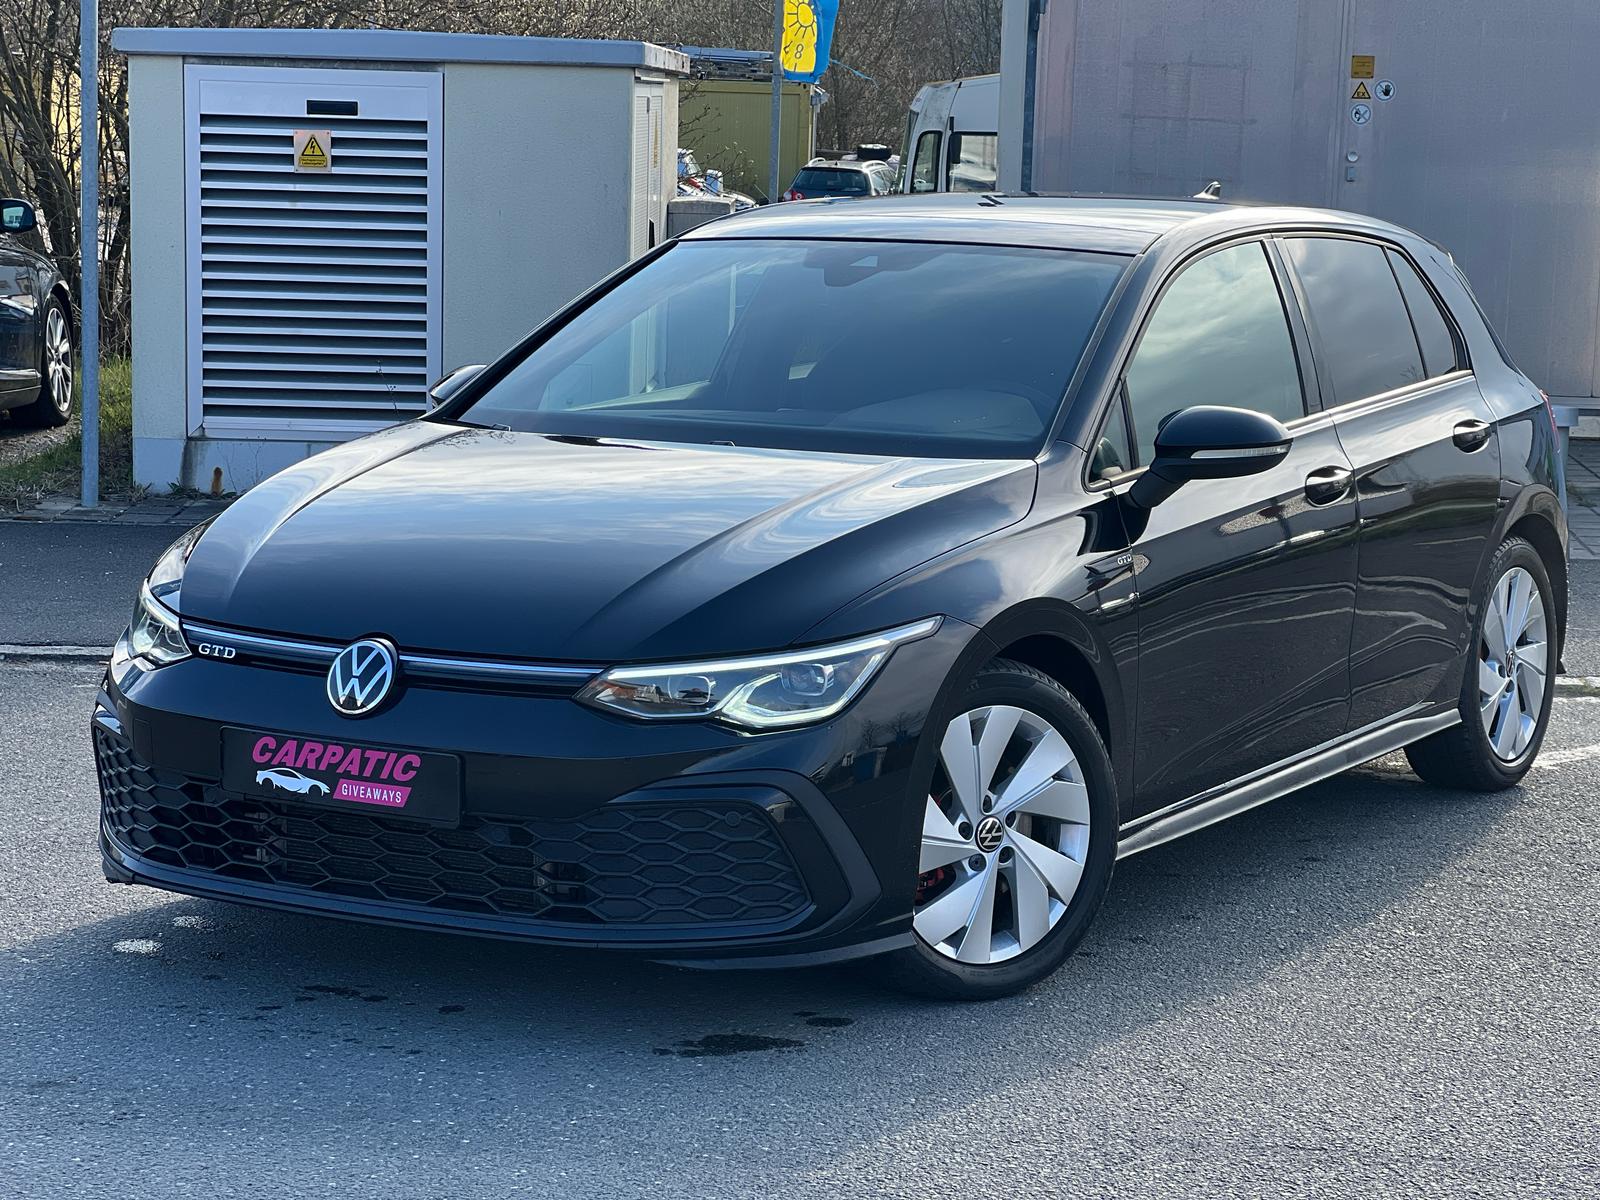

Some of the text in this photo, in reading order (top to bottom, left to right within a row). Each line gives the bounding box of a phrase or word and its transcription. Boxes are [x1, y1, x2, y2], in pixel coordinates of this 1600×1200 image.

[1117, 553, 1132, 565] GTD
[198, 643, 236, 659] GTD
[252, 736, 422, 782] CARPATIC
[341, 783, 402, 803] GIVEAWAYS
